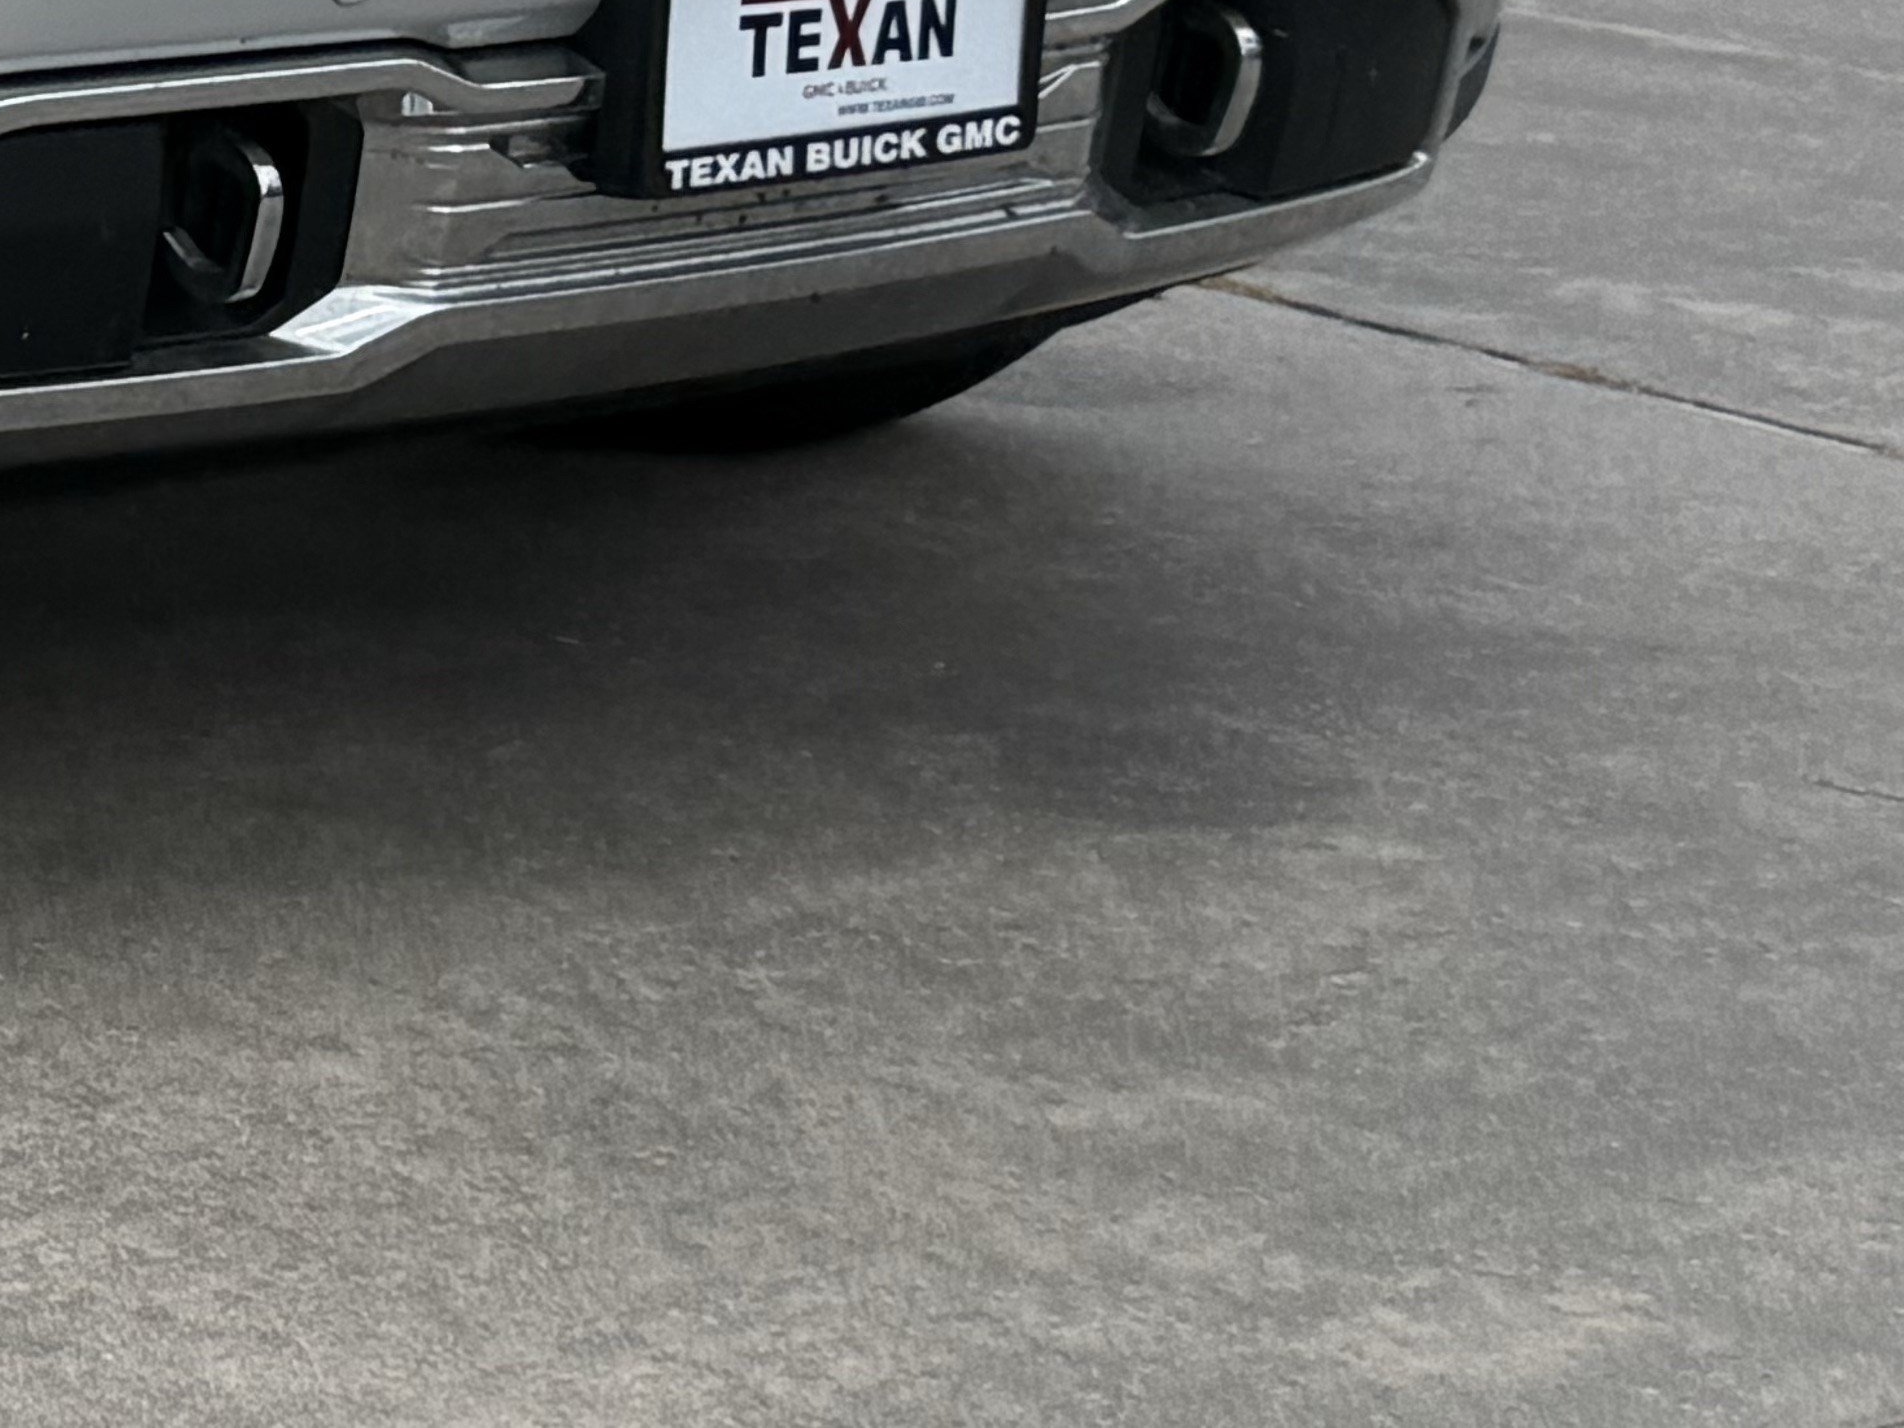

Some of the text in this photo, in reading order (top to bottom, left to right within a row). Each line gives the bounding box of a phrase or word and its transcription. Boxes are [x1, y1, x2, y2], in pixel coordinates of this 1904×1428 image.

[665, 114, 1021, 190] TEXAN BUICK GMC
